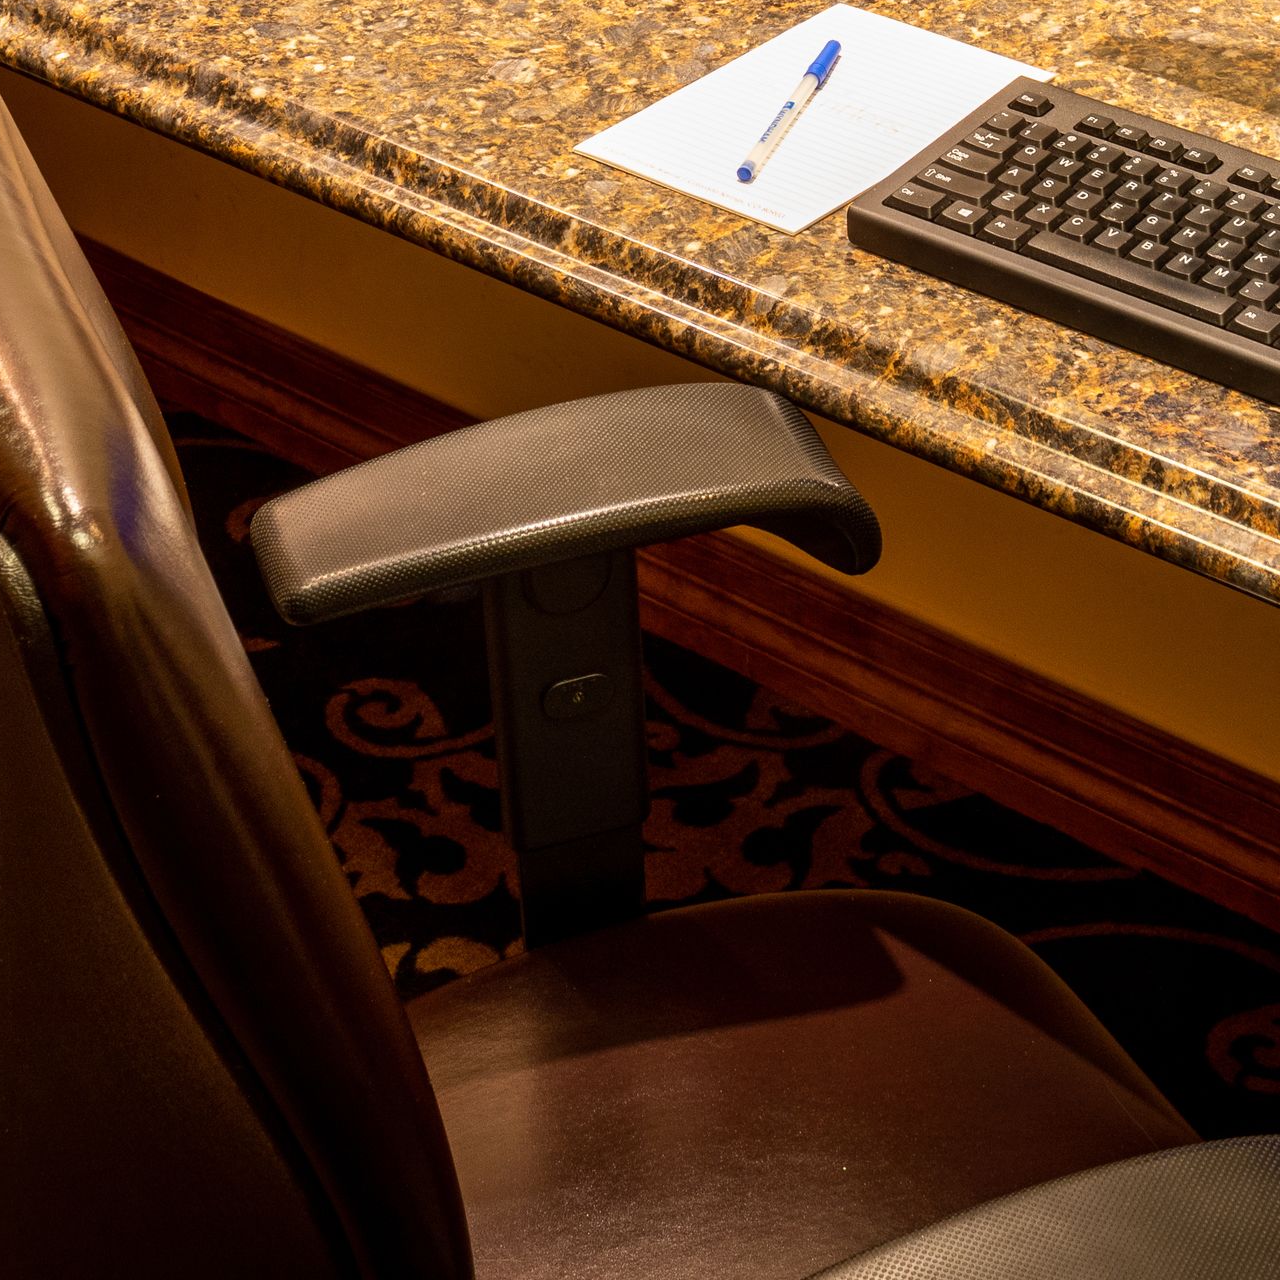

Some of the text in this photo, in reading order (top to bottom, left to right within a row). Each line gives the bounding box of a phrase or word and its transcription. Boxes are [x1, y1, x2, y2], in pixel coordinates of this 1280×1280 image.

[1154, 139, 1166, 147] F3
[1024, 146, 1036, 155] Q
[1059, 158, 1074, 167] W
[1008, 168, 1019, 176] A
[1091, 169, 1103, 178] E
[1242, 168, 1254, 176] F5
[1042, 180, 1054, 188] S
[1126, 182, 1138, 191] R
[1002, 193, 1015, 201] Z
[1076, 191, 1089, 200] D
[1162, 193, 1173, 201] T
[1037, 205, 1050, 213] X
[1110, 202, 1123, 211] F
[1199, 206, 1211, 214] Y
[1071, 217, 1084, 226] C
[1146, 216, 1158, 225] G
[1234, 218, 1245, 227] U
[1107, 228, 1119, 237] V
[1183, 228, 1196, 238] H
[1141, 241, 1153, 250] B
[1218, 241, 1229, 249] J
[1179, 255, 1192, 264] N
[1255, 253, 1268, 262] K
[1215, 268, 1229, 277] M
